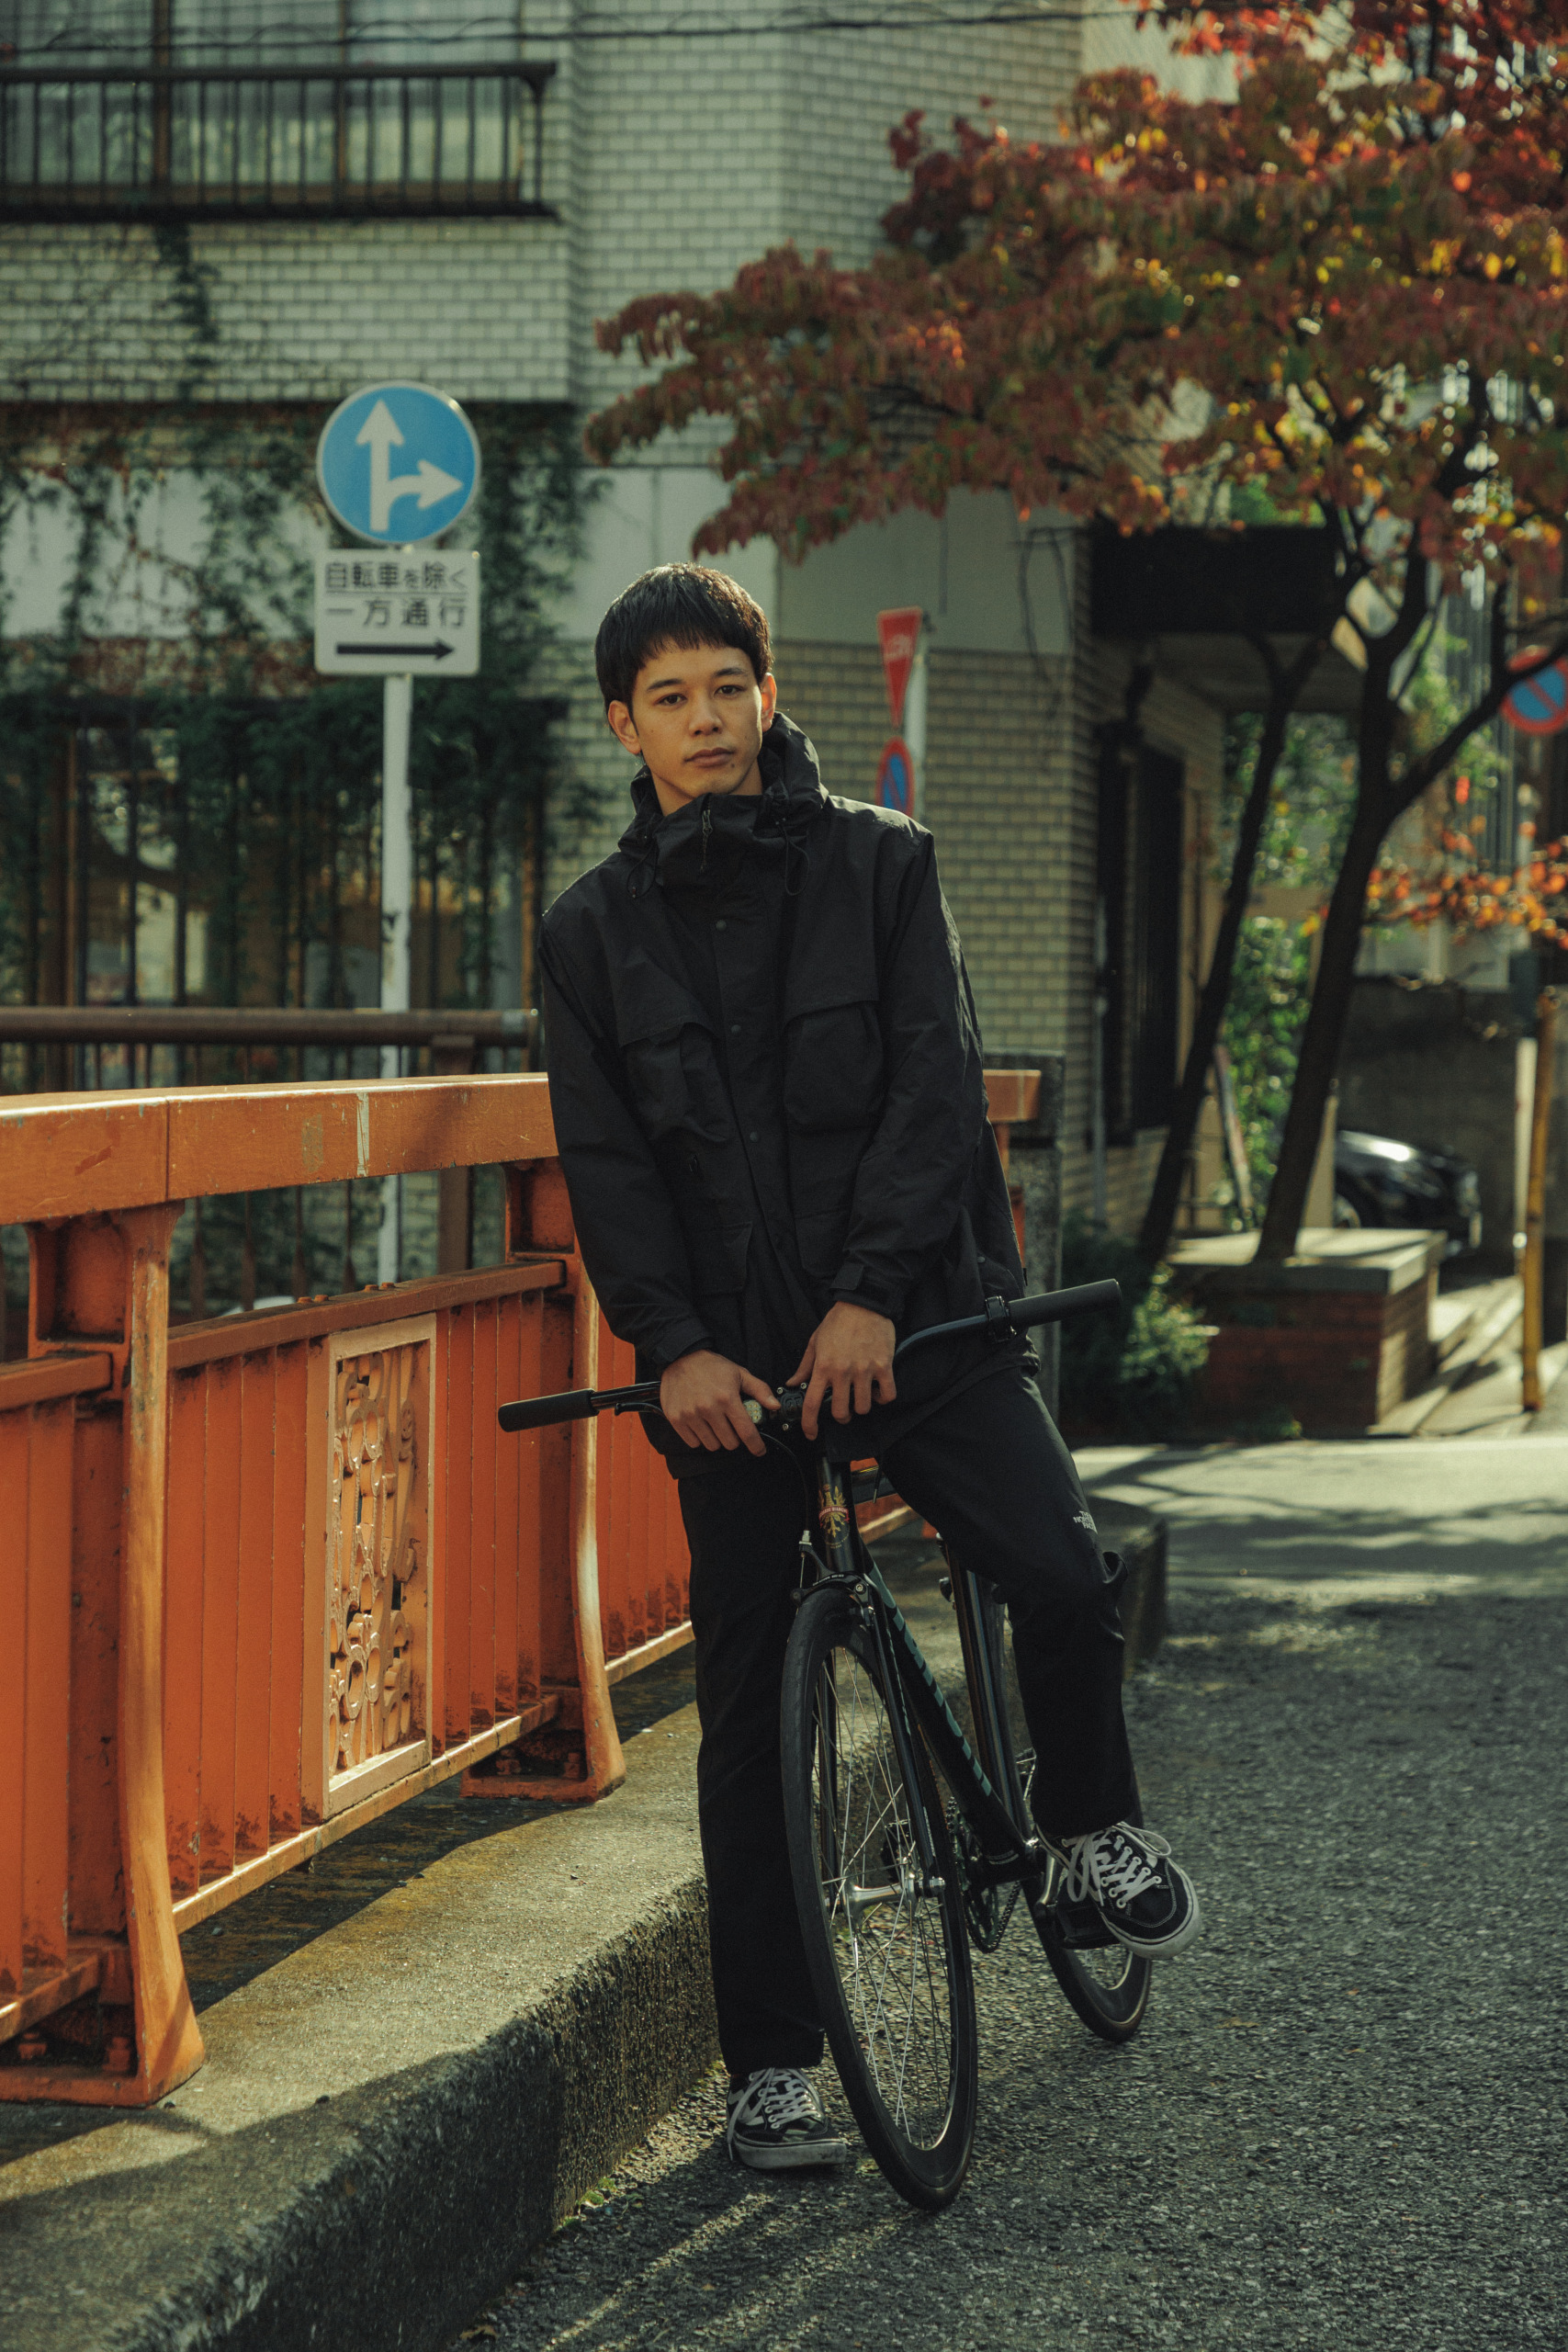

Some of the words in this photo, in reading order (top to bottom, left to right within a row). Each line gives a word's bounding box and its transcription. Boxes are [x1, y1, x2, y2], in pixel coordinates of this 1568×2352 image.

[326, 560, 468, 589] 自転車を除く
[326, 596, 468, 628] 一方通行
